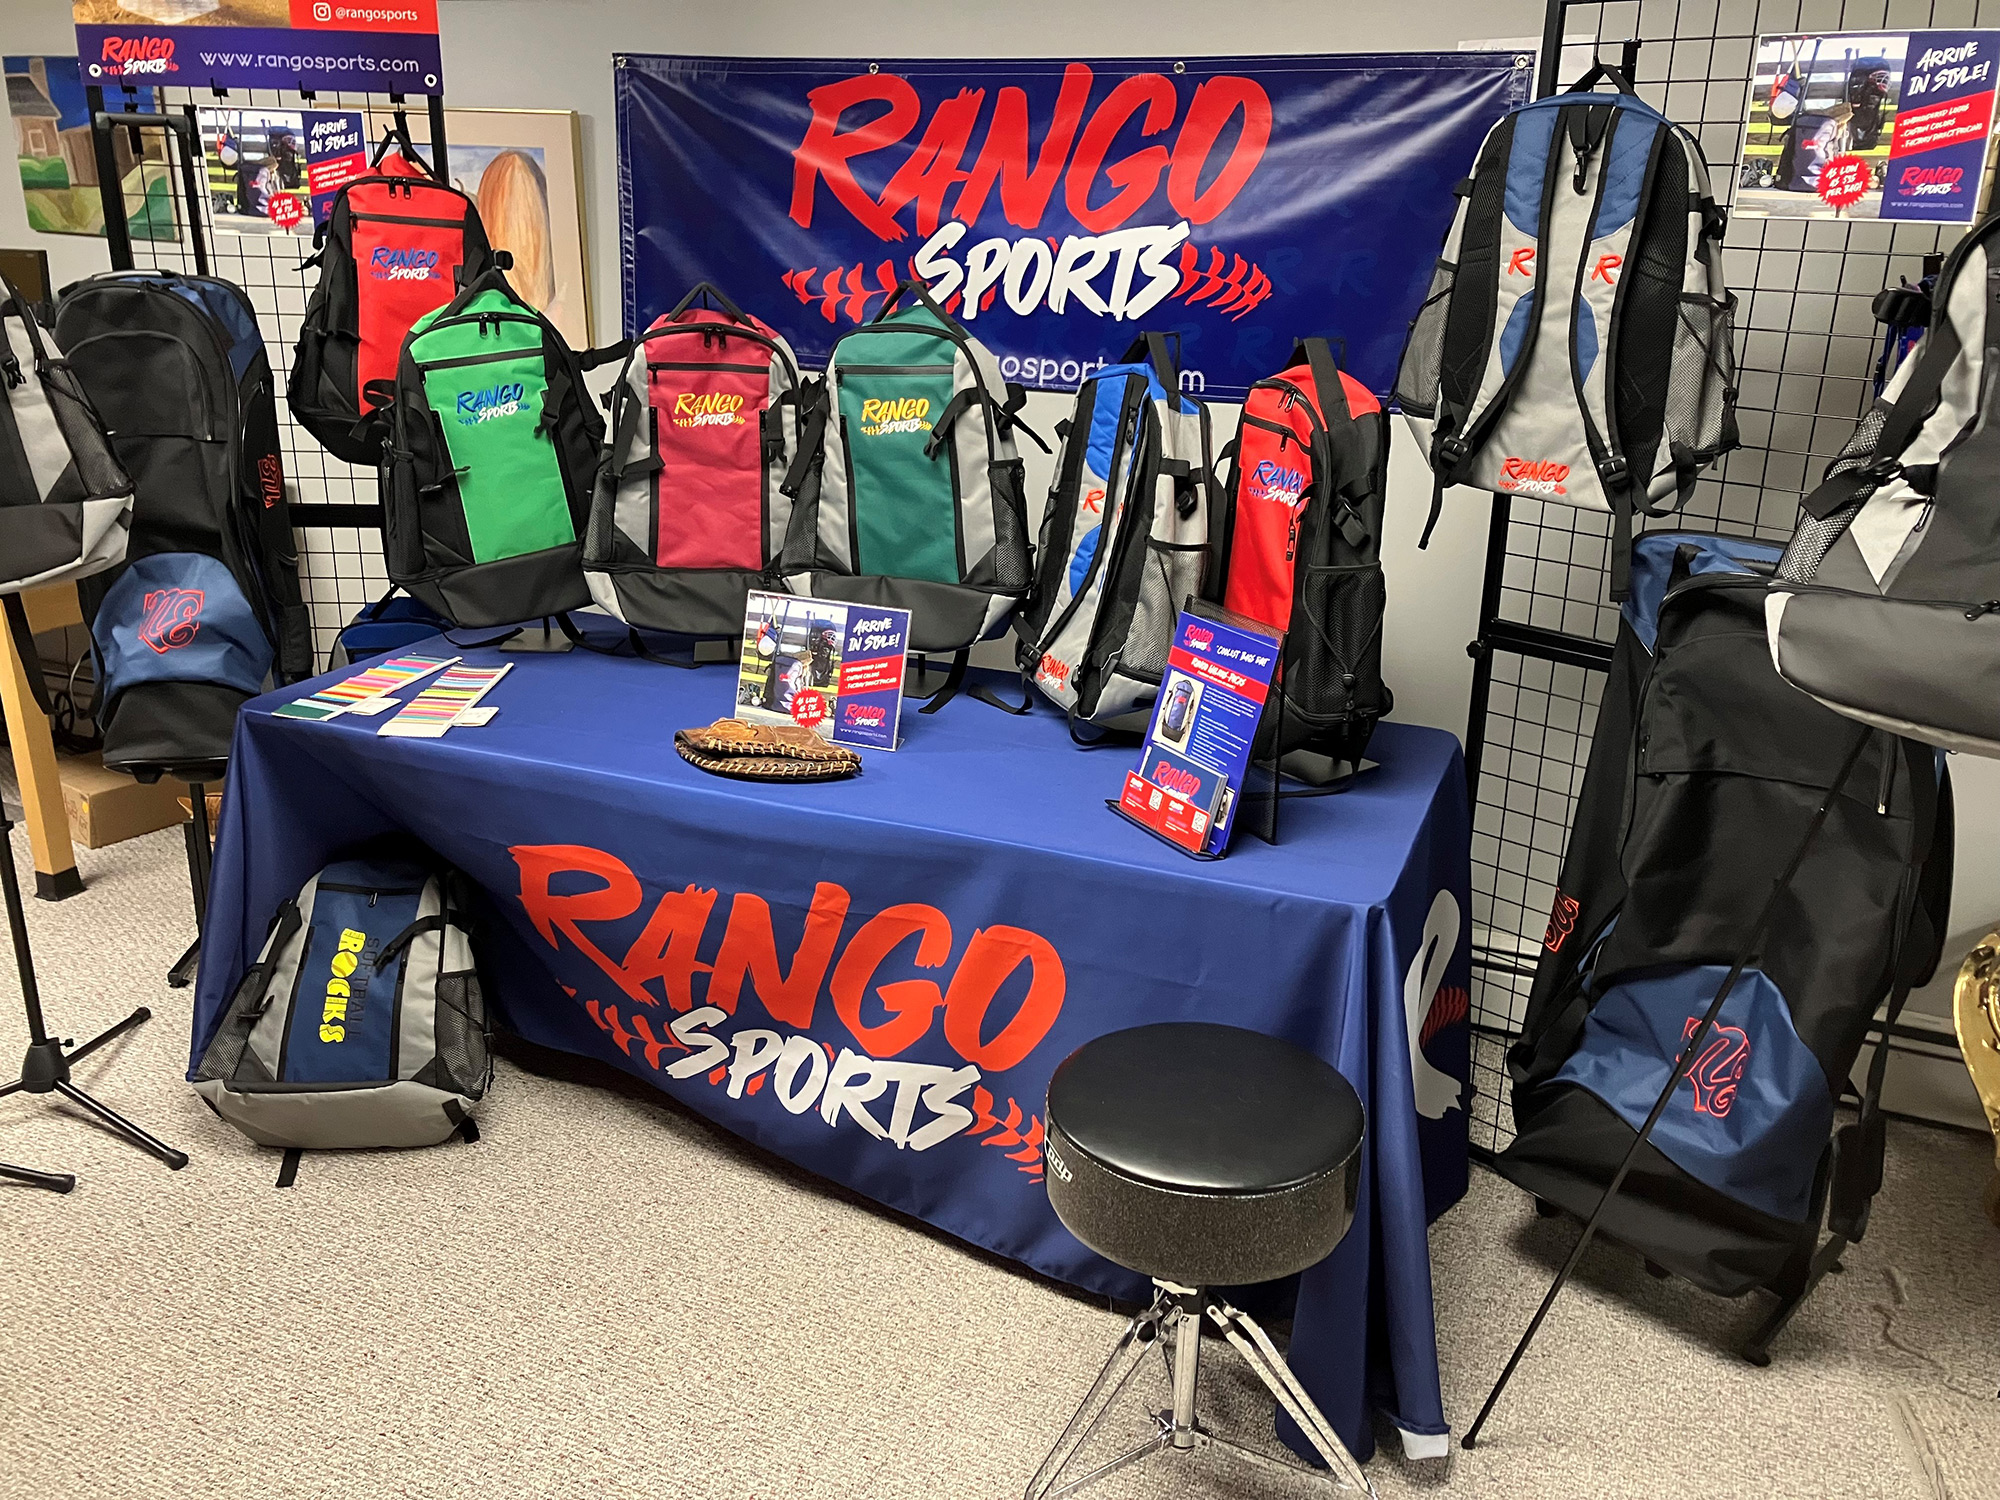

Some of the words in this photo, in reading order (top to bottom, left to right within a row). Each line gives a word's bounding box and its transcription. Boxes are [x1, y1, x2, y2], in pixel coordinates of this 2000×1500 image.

[335, 7, 418, 22] @rangosports
[102, 37, 175, 61] RANGO
[1916, 41, 1978, 73] ARRIVE
[123, 58, 167, 75] SPORTS
[200, 52, 419, 73] www.rangosports.com
[1907, 73, 1931, 97] IN
[1931, 60, 1991, 93] STYLE!
[311, 119, 347, 137] ARRIVE
[310, 138, 323, 154] IN
[325, 132, 358, 151] STYLE!
[789, 62, 1273, 243] RANGO
[1826, 167, 1838, 179] AS
[1840, 162, 1859, 176] LOW
[1900, 166, 1963, 186] RANGO
[1826, 187, 1842, 199] PER
[1913, 183, 1953, 196] SPORTS
[371, 247, 439, 268] RANGO
[1507, 247, 1536, 276] R
[388, 266, 430, 281] SPORTS
[915, 221, 1191, 322] SPORTS
[1591, 254, 1623, 285] R
[456, 383, 524, 414] RANGO
[674, 392, 744, 416] RANGO
[478, 400, 519, 424] SPORTS
[692, 412, 735, 427] SPORTS
[861, 397, 931, 424] RANGO
[879, 418, 921, 436] SPORTS
[1500, 456, 1570, 482] RANGO
[1514, 478, 1557, 494] SPORTS
[1082, 488, 1105, 513] R
[853, 617, 893, 637] ARRIVE
[1184, 624, 1214, 643] RANGO
[847, 637, 862, 652] IN
[863, 633, 900, 652] STYLE!
[844, 703, 886, 720] RANGO
[854, 718, 880, 727] SPORTS
[1152, 760, 1201, 797] RANGO
[507, 845, 1066, 1072] RANGO
[319, 928, 367, 1043] ROCKS
[665, 1006, 982, 1151] SPORTS
